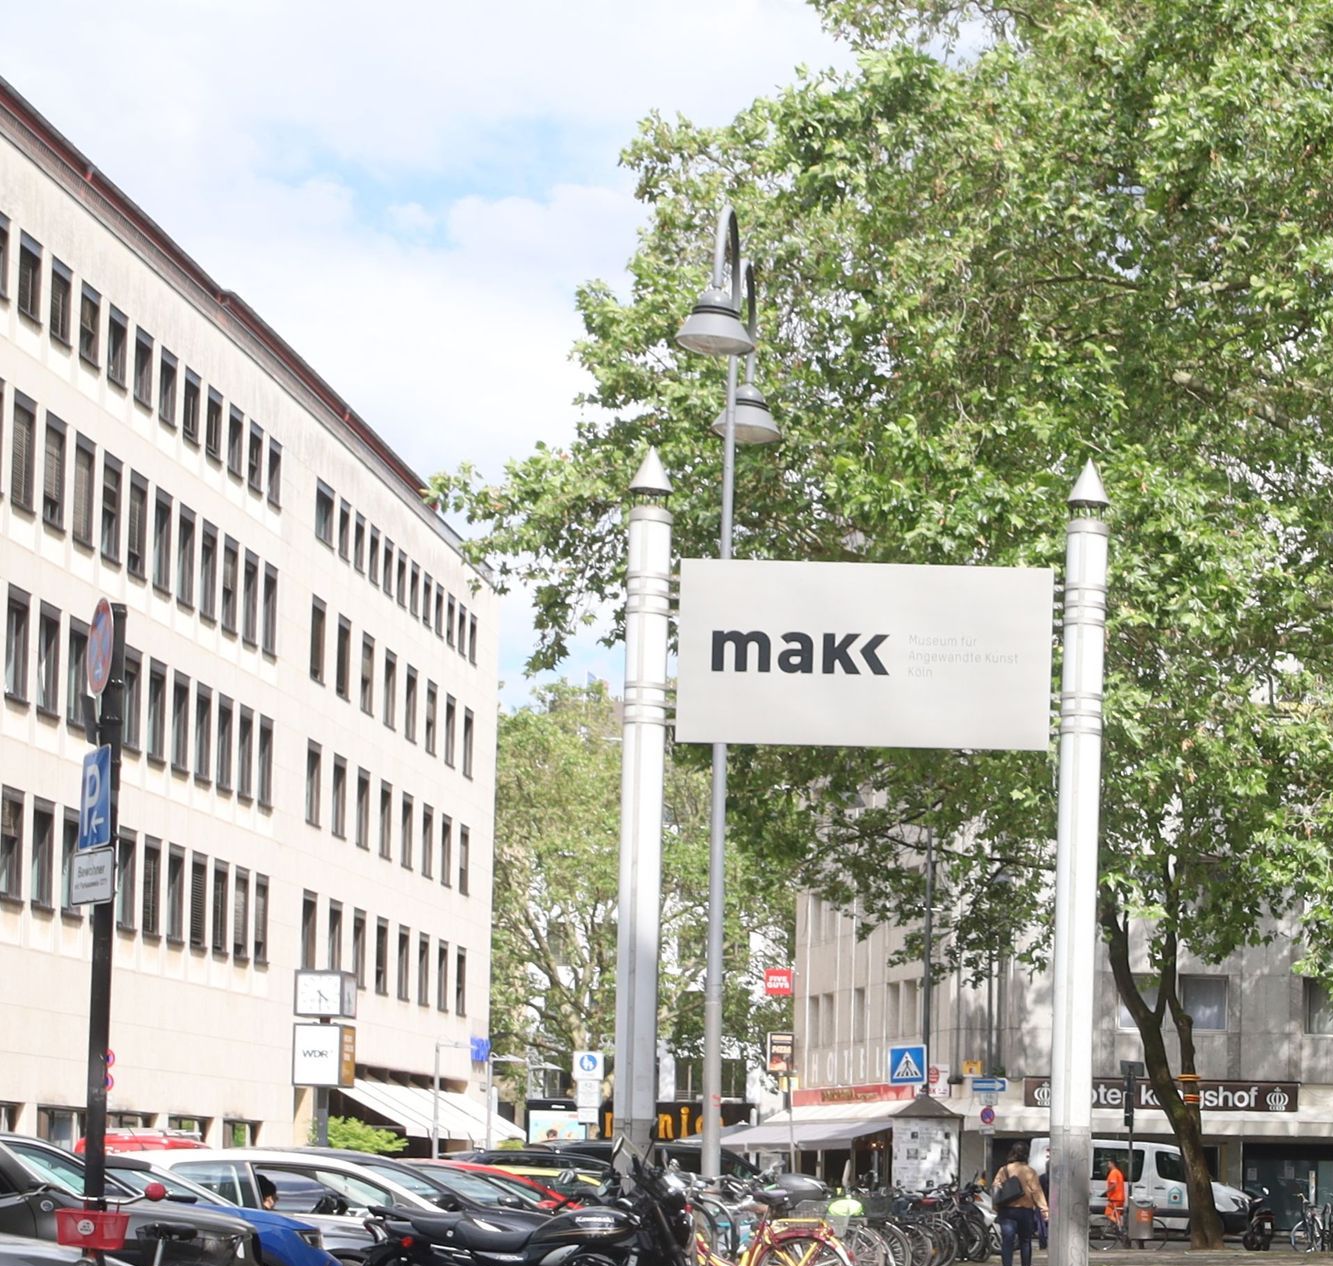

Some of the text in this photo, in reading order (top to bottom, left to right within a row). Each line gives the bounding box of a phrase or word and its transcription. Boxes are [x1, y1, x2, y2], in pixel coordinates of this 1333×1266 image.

[908, 634, 957, 647] Museum
[908, 650, 1019, 664] Angewandte Kunst
[302, 1049, 329, 1059] WDR
